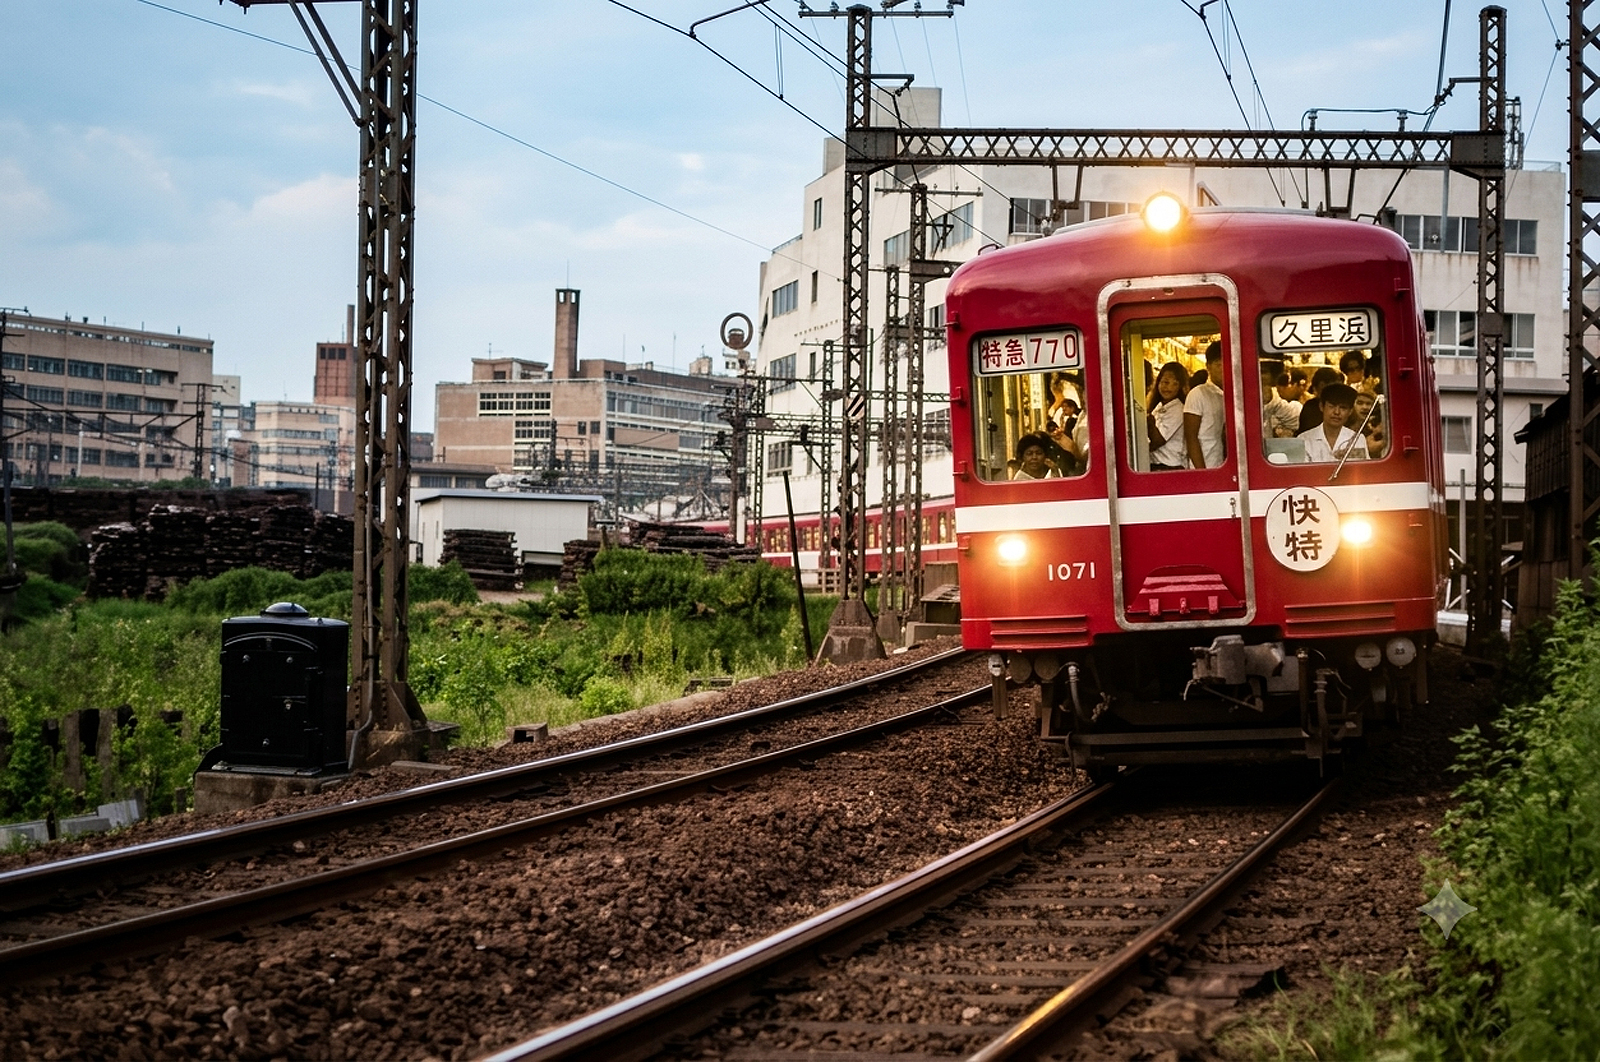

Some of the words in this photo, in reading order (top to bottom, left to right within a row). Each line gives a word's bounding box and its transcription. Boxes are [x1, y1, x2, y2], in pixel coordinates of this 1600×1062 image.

[1278, 316, 1366, 346] 久里浜
[1282, 494, 1322, 562] 快特
[1047, 561, 1096, 581] 1071
